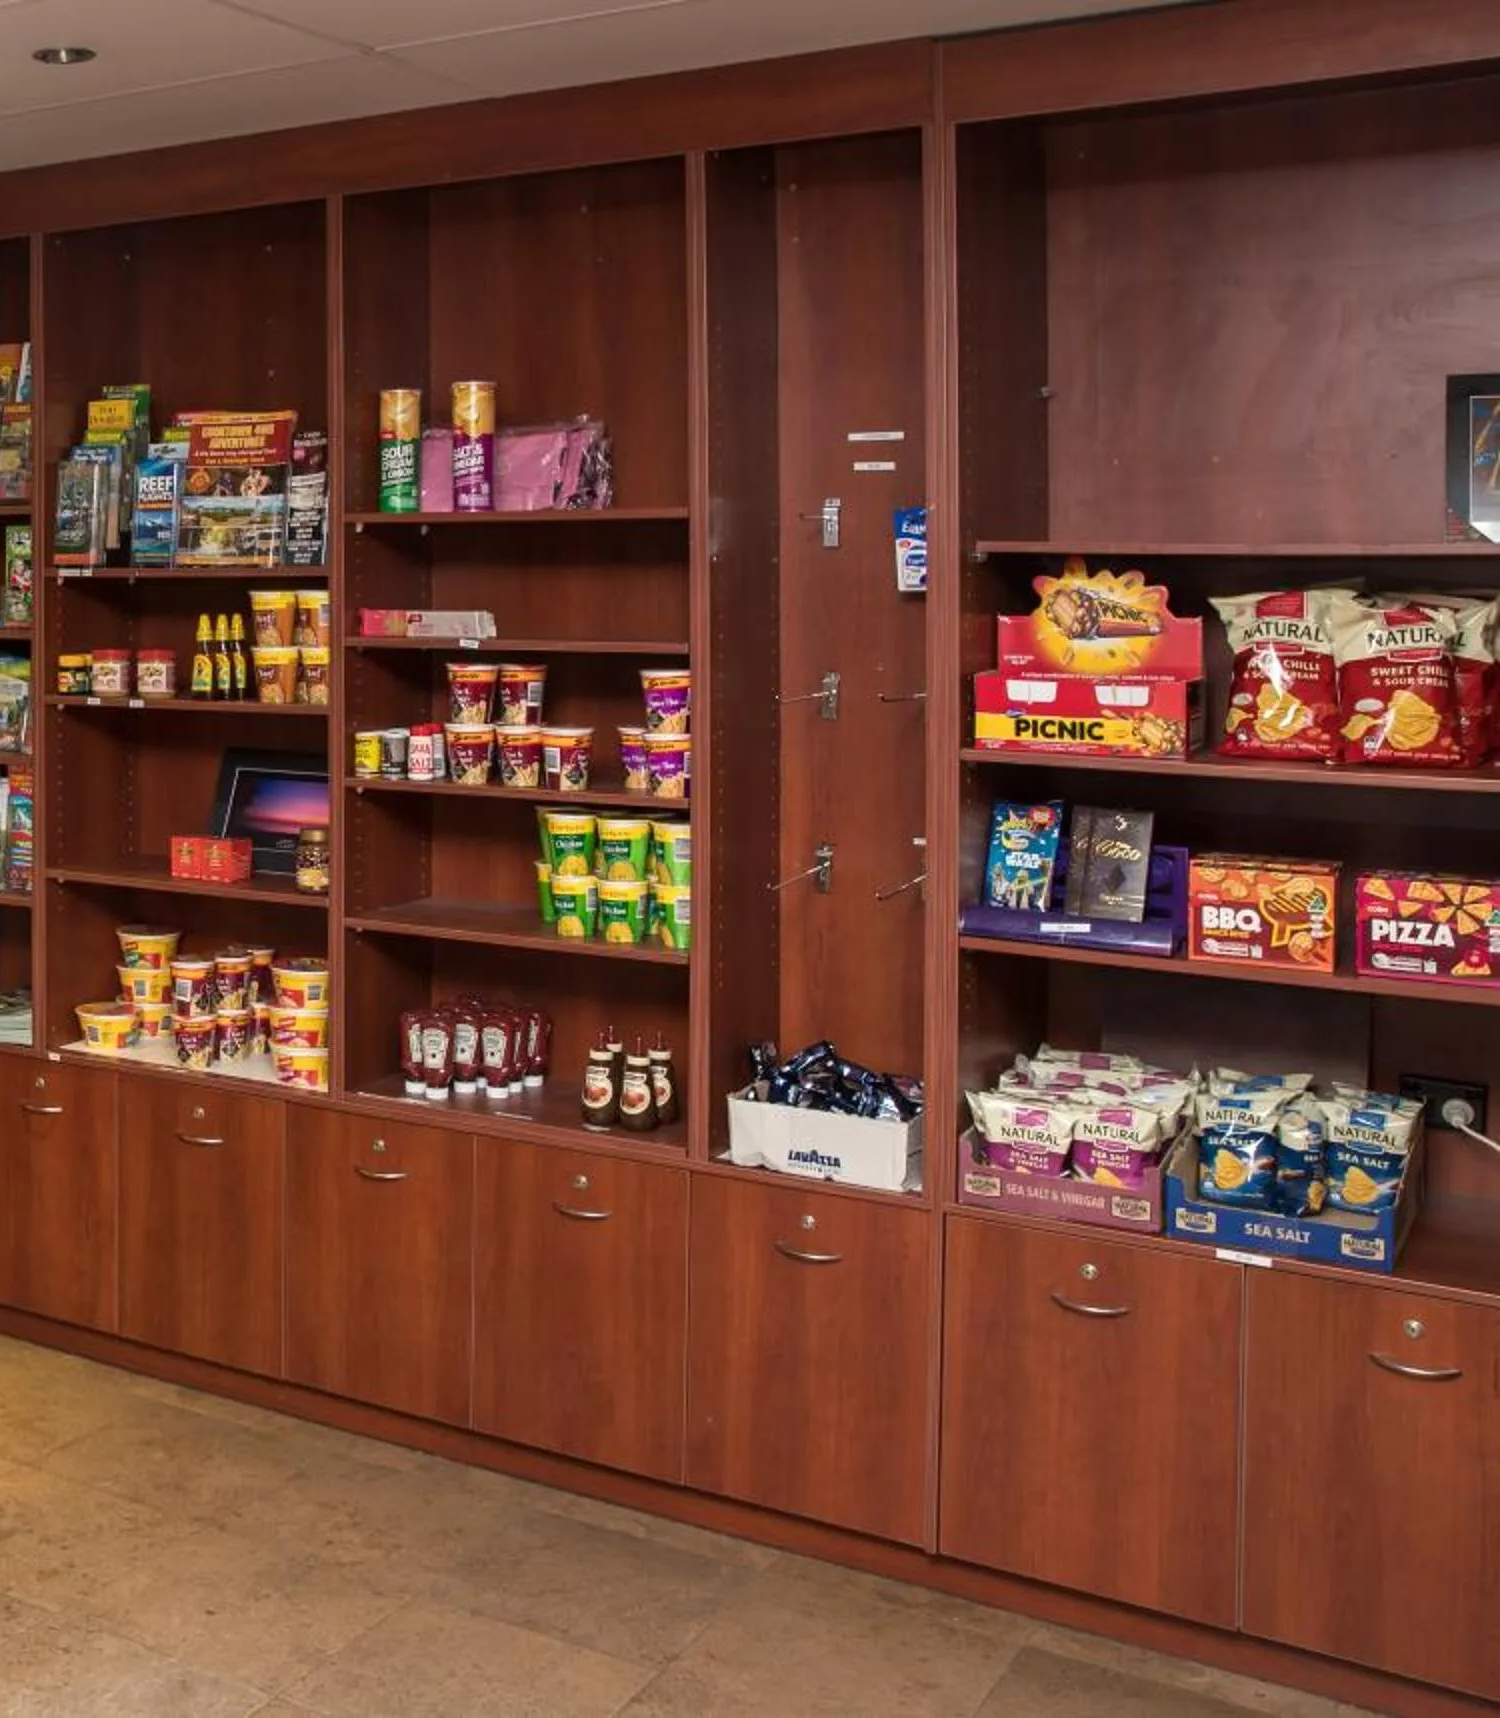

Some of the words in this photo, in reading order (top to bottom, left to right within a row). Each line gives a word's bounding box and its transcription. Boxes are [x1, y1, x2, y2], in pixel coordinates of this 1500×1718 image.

[381, 444, 414, 461] SOUR
[138, 476, 174, 492] REEF
[1242, 621, 1324, 643] NATURAL
[1370, 665, 1412, 677] SWEET
[1417, 664, 1449, 677] CHIL
[1384, 676, 1414, 687] SOUR
[1014, 718, 1105, 741] PICNIC
[1202, 904, 1263, 934] BBQ
[1371, 918, 1456, 948] PIZZA
[1000, 1126, 1061, 1147] NATURAL
[1082, 1123, 1141, 1144] NATURAL
[1333, 1124, 1398, 1147] NATURAL
[787, 1149, 842, 1169] LAVAZZA
[1336, 1151, 1360, 1164] SEA
[1363, 1156, 1391, 1170] SALT
[1005, 1183, 1026, 1197] SEA
[1027, 1186, 1050, 1200] SALT
[1061, 1191, 1106, 1209] VINEGAR
[1243, 1223, 1271, 1239] SEA
[1273, 1227, 1312, 1244] SALT
